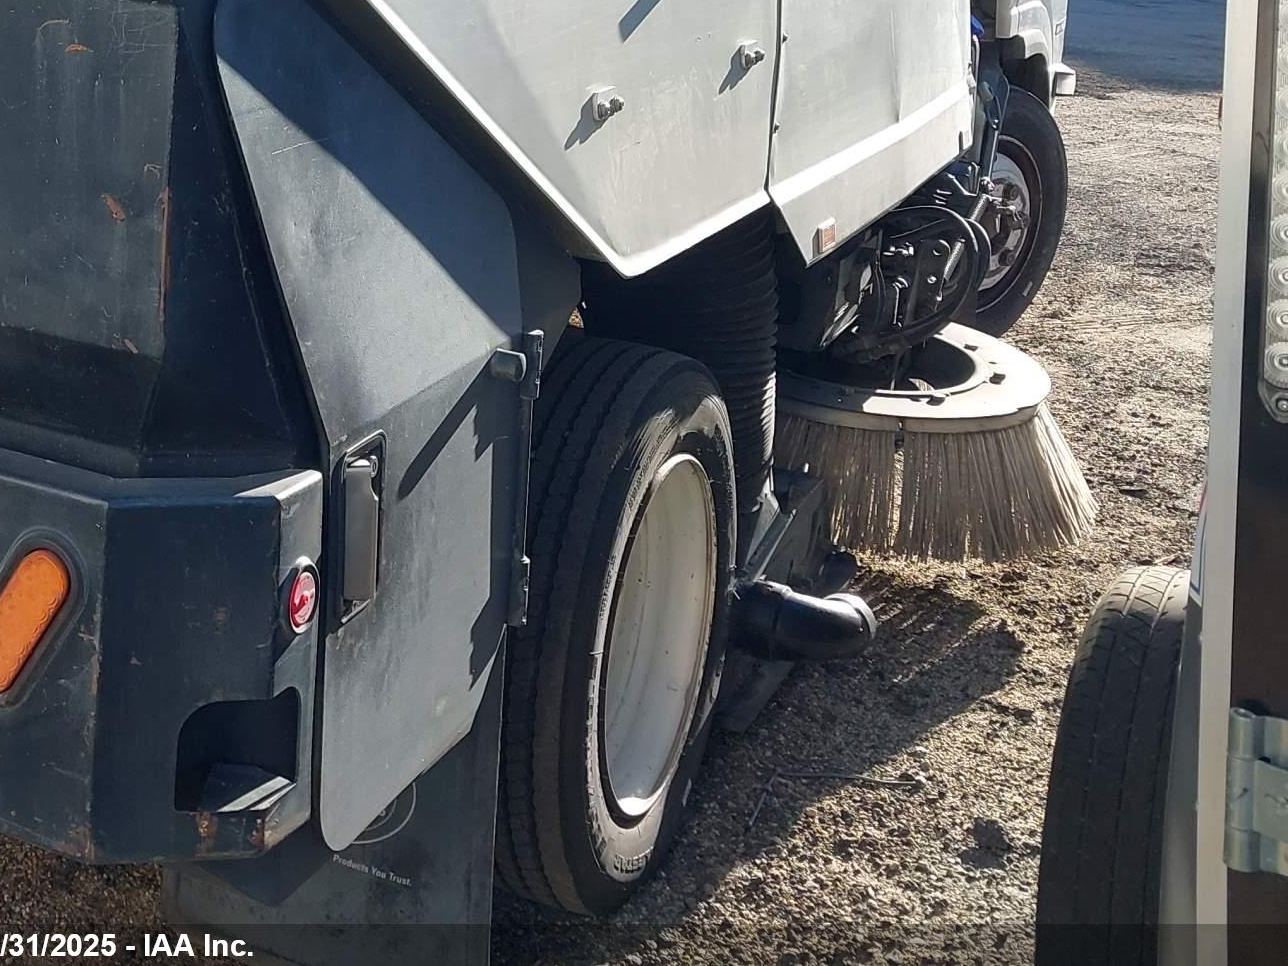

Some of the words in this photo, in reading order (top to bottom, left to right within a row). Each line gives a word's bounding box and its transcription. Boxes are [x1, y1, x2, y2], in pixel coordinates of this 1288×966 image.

[332, 854, 369, 874] Products
[371, 865, 387, 880] You
[388, 871, 413, 887] Trust.
